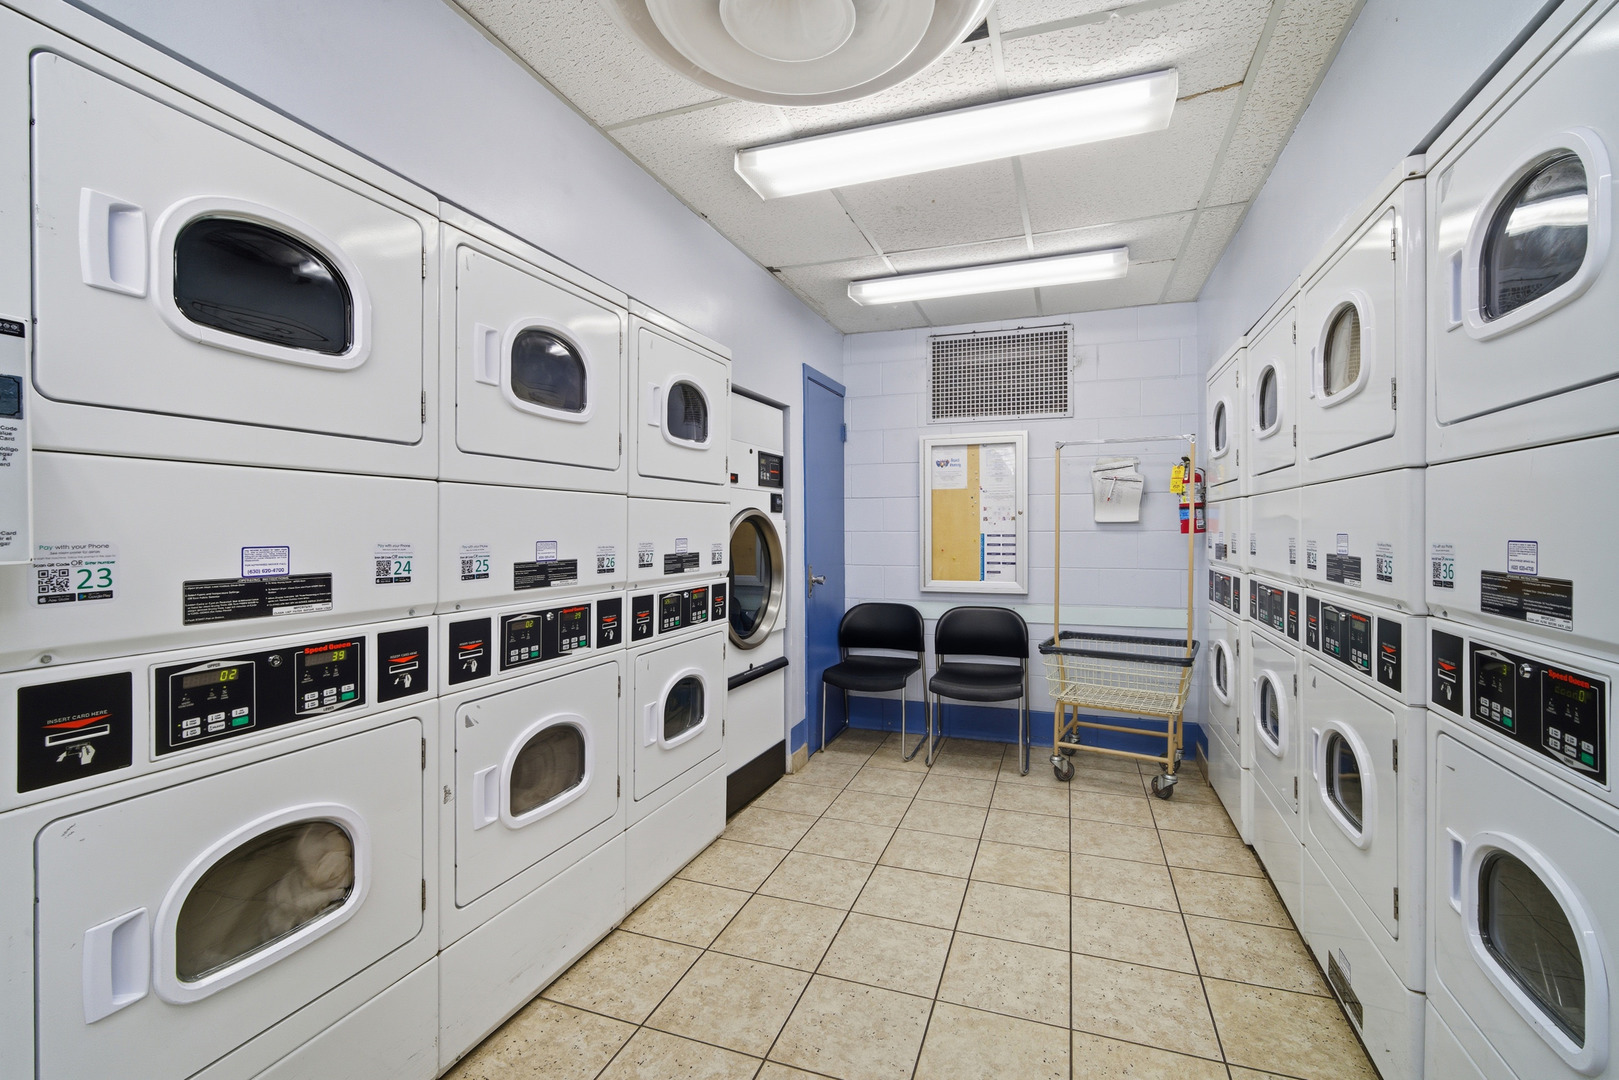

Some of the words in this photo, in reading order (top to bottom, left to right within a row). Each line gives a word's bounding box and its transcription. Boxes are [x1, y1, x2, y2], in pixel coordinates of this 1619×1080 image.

[606, 557, 615, 568] 26
[646, 553, 653, 562] 27
[394, 561, 412, 575] 24
[475, 559, 489, 572] 25
[1384, 560, 1392, 574] 35
[1442, 563, 1454, 579] 36
[77, 568, 113, 589] 23
[525, 620, 534, 628] 02
[304, 645, 328, 654] Speed
[328, 642, 352, 650] Queen
[332, 650, 345, 661] 39
[220, 669, 237, 681] 02
[1548, 669, 1568, 681] Speed
[1568, 676, 1590, 689] Queen
[47, 716, 70, 725] INSERT
